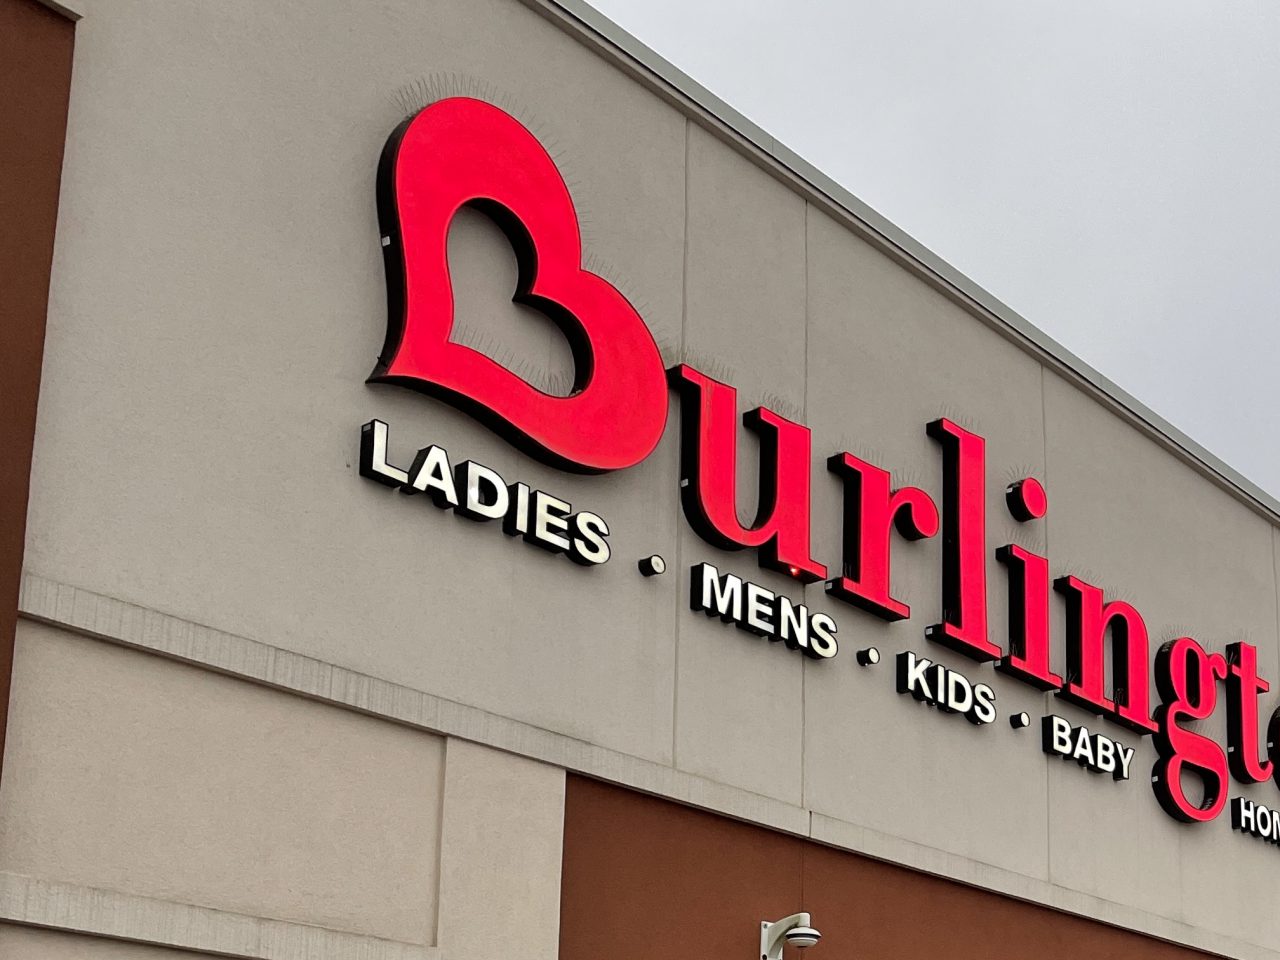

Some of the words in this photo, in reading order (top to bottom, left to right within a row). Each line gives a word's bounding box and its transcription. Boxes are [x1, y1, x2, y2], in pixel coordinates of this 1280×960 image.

[362, 419, 611, 566] LADIES
[694, 562, 838, 660] MENS
[902, 651, 996, 724] KIDS
[1046, 714, 1135, 780] BABY
